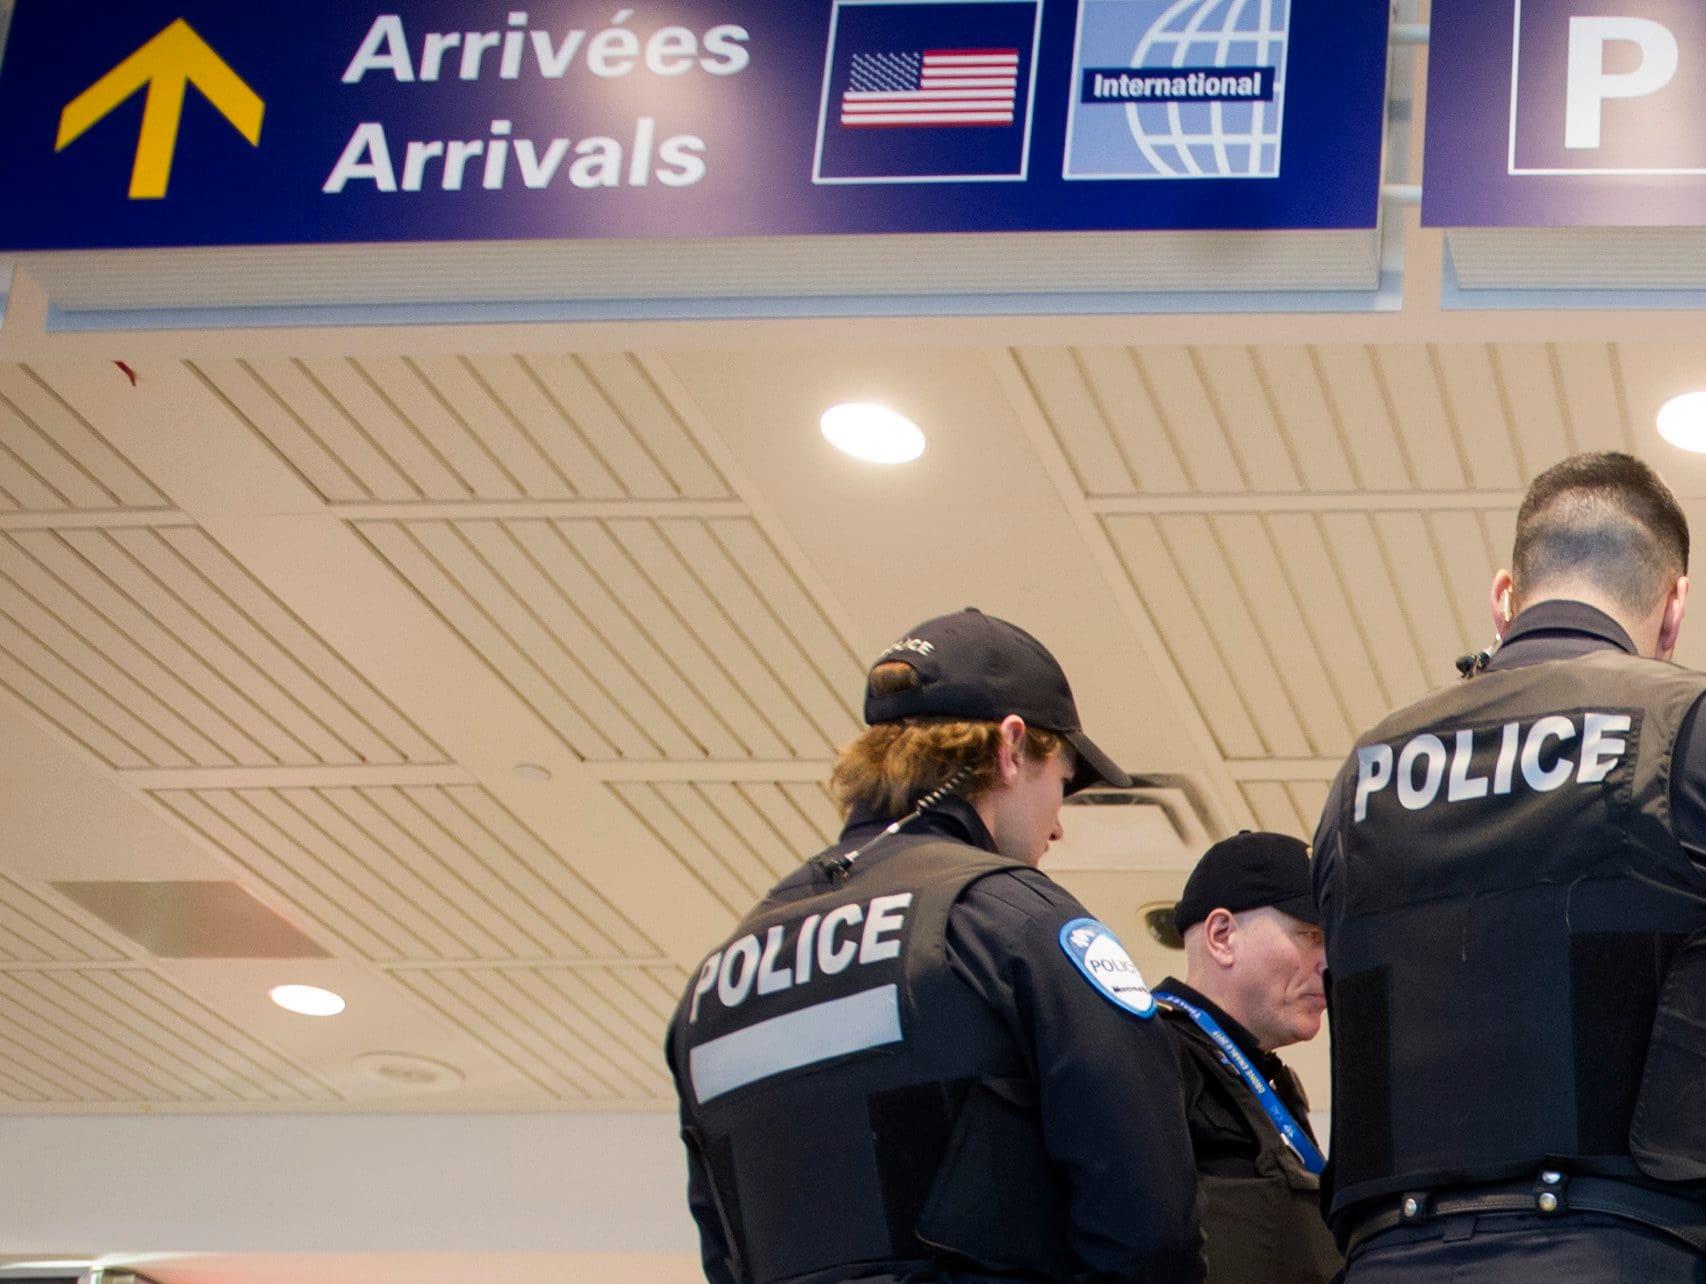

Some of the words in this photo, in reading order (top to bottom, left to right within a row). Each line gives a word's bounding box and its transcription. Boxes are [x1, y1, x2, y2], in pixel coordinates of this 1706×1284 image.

[341, 10, 750, 83] Arrivées
[1093, 73, 1261, 99] International
[1564, 16, 1679, 149] P
[322, 117, 706, 193] Arrivals
[1353, 712, 1631, 823] POLICE
[689, 892, 913, 1024] POLICE
